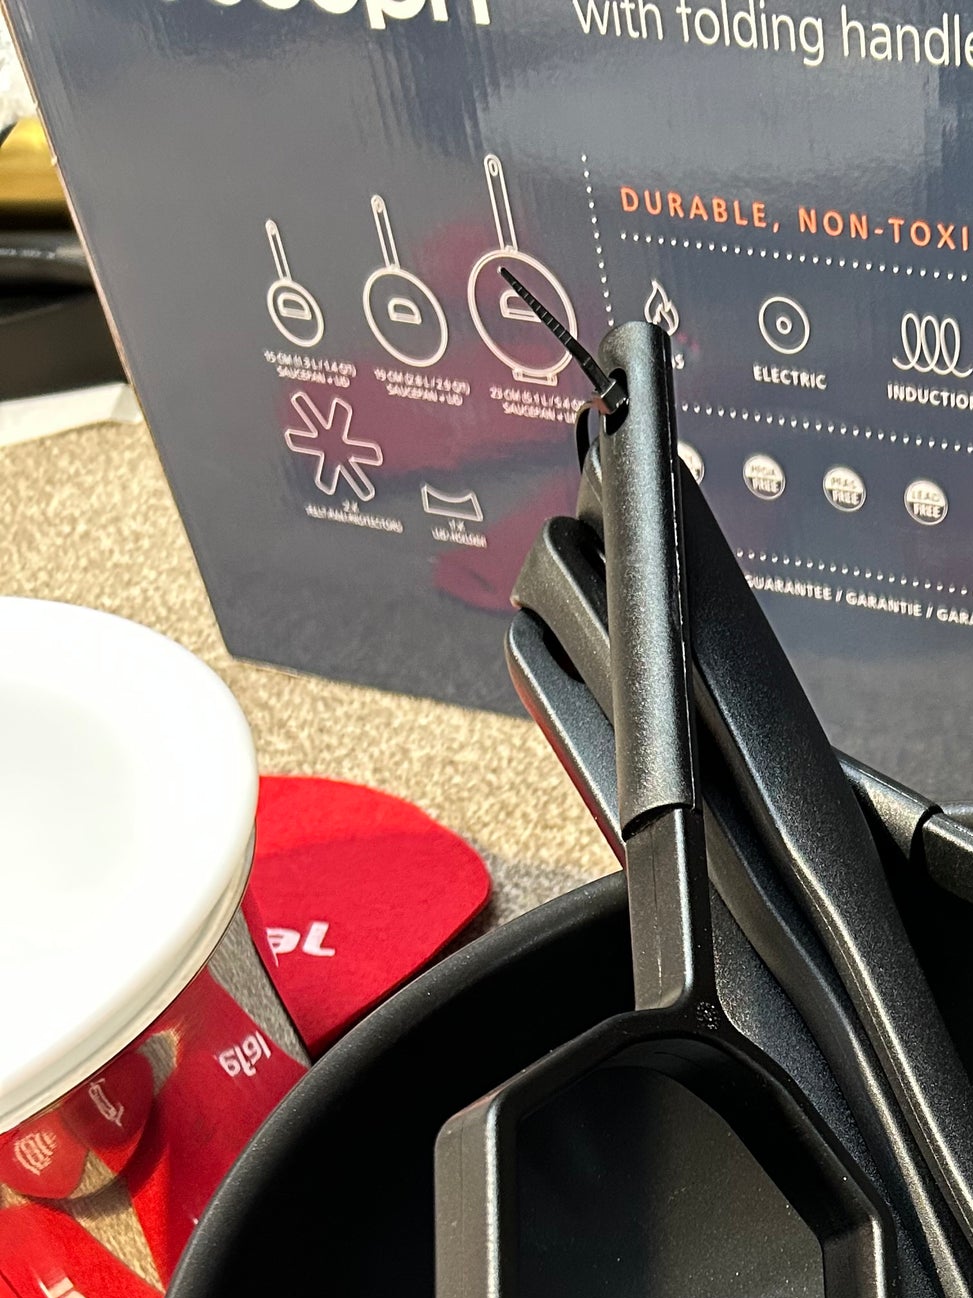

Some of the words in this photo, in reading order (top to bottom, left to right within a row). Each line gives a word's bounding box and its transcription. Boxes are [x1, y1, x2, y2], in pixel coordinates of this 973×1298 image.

[620, 185, 780, 234] DURABLE,
[753, 363, 828, 390] ELECTRIC
[912, 503, 942, 519] FREE
[845, 590, 923, 618] GARANTIE
